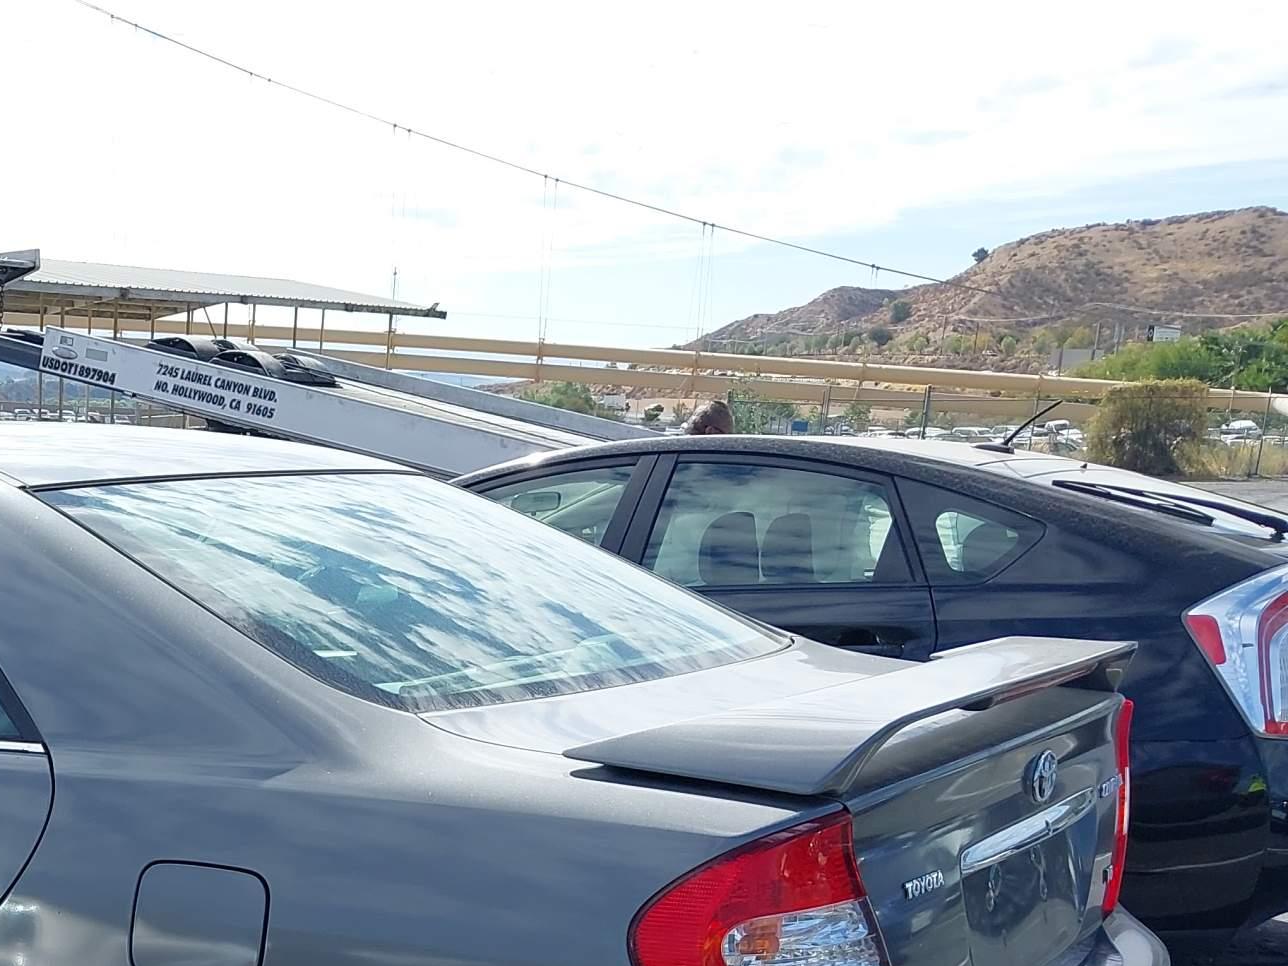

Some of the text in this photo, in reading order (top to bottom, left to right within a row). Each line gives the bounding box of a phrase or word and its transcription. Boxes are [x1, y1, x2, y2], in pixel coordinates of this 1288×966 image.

[154, 380, 275, 419] NO. HOLLYWOOD, CA 91605
[156, 364, 278, 403] 7245 LAUREL CANYON BLVD.
[905, 869, 945, 900] TOYOTA
